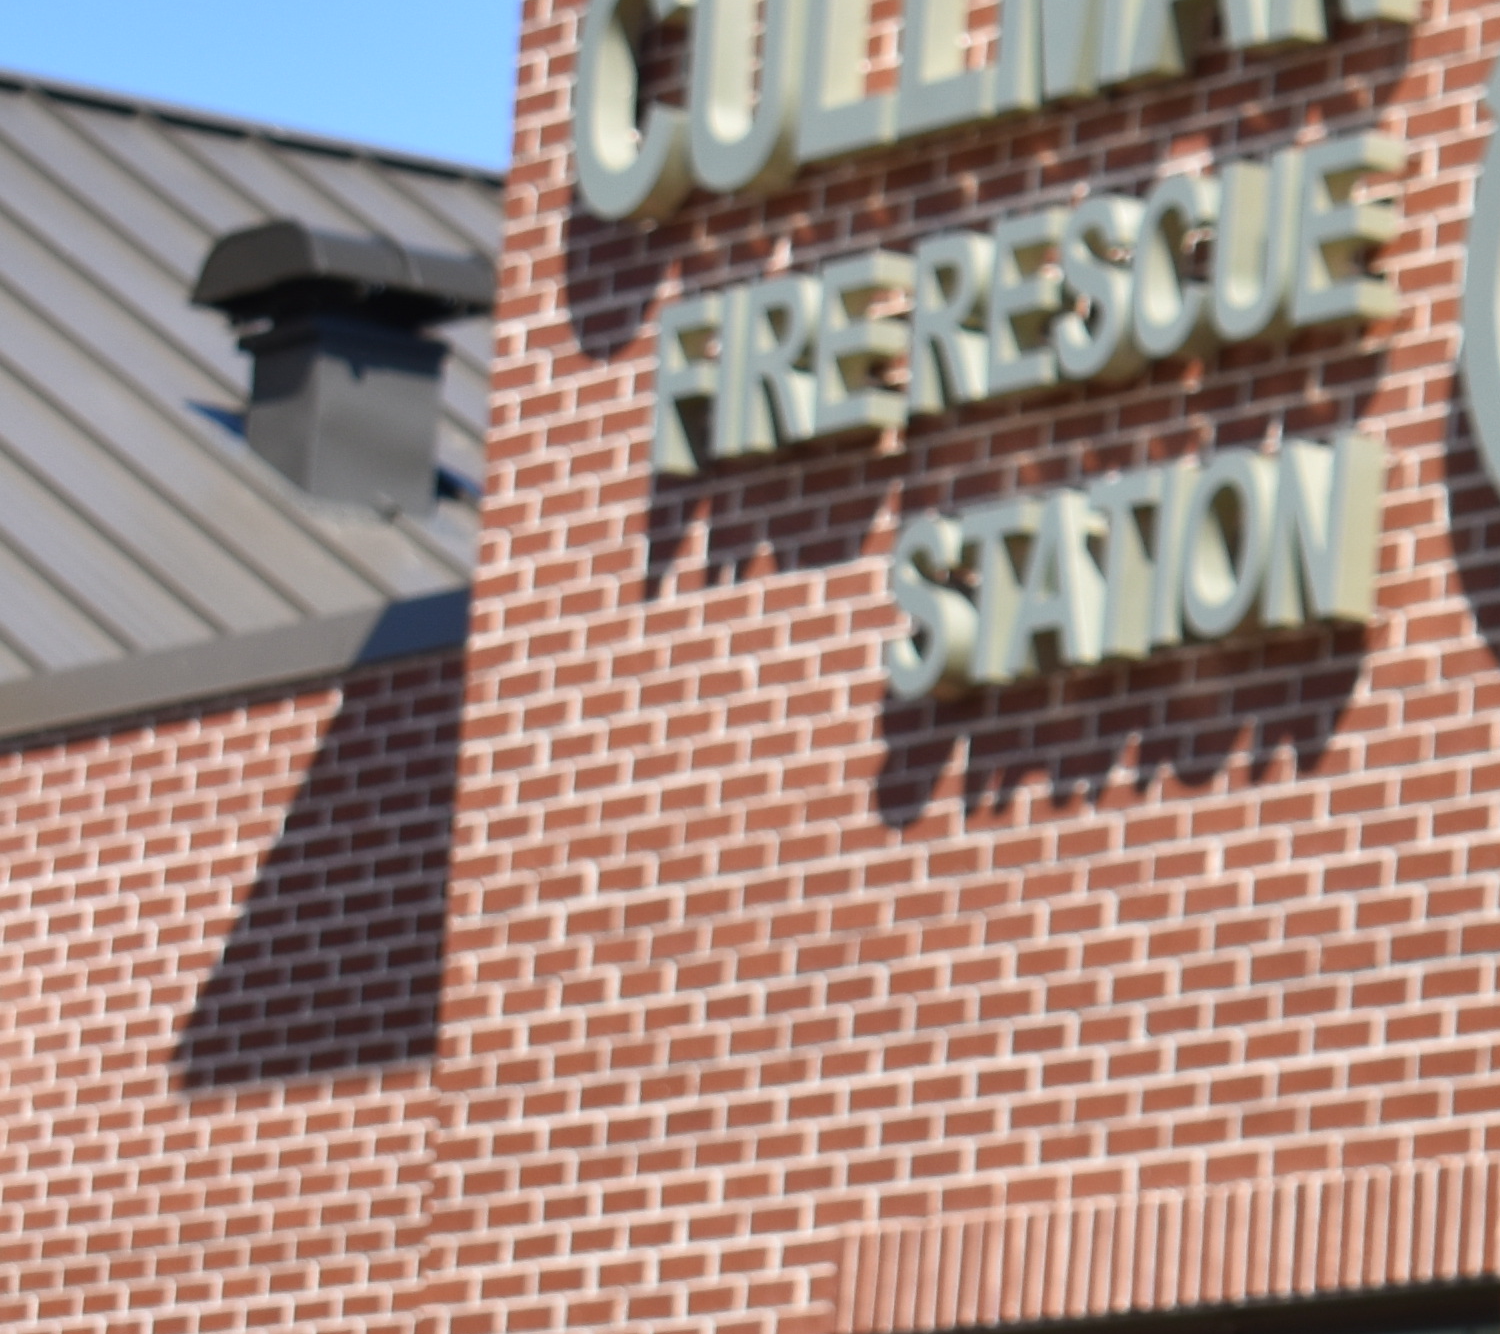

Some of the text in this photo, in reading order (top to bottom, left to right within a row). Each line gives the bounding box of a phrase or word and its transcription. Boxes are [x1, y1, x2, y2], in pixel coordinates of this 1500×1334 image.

[650, 133, 1402, 475] FIRE RESCUE
[888, 433, 1384, 701] STATION
